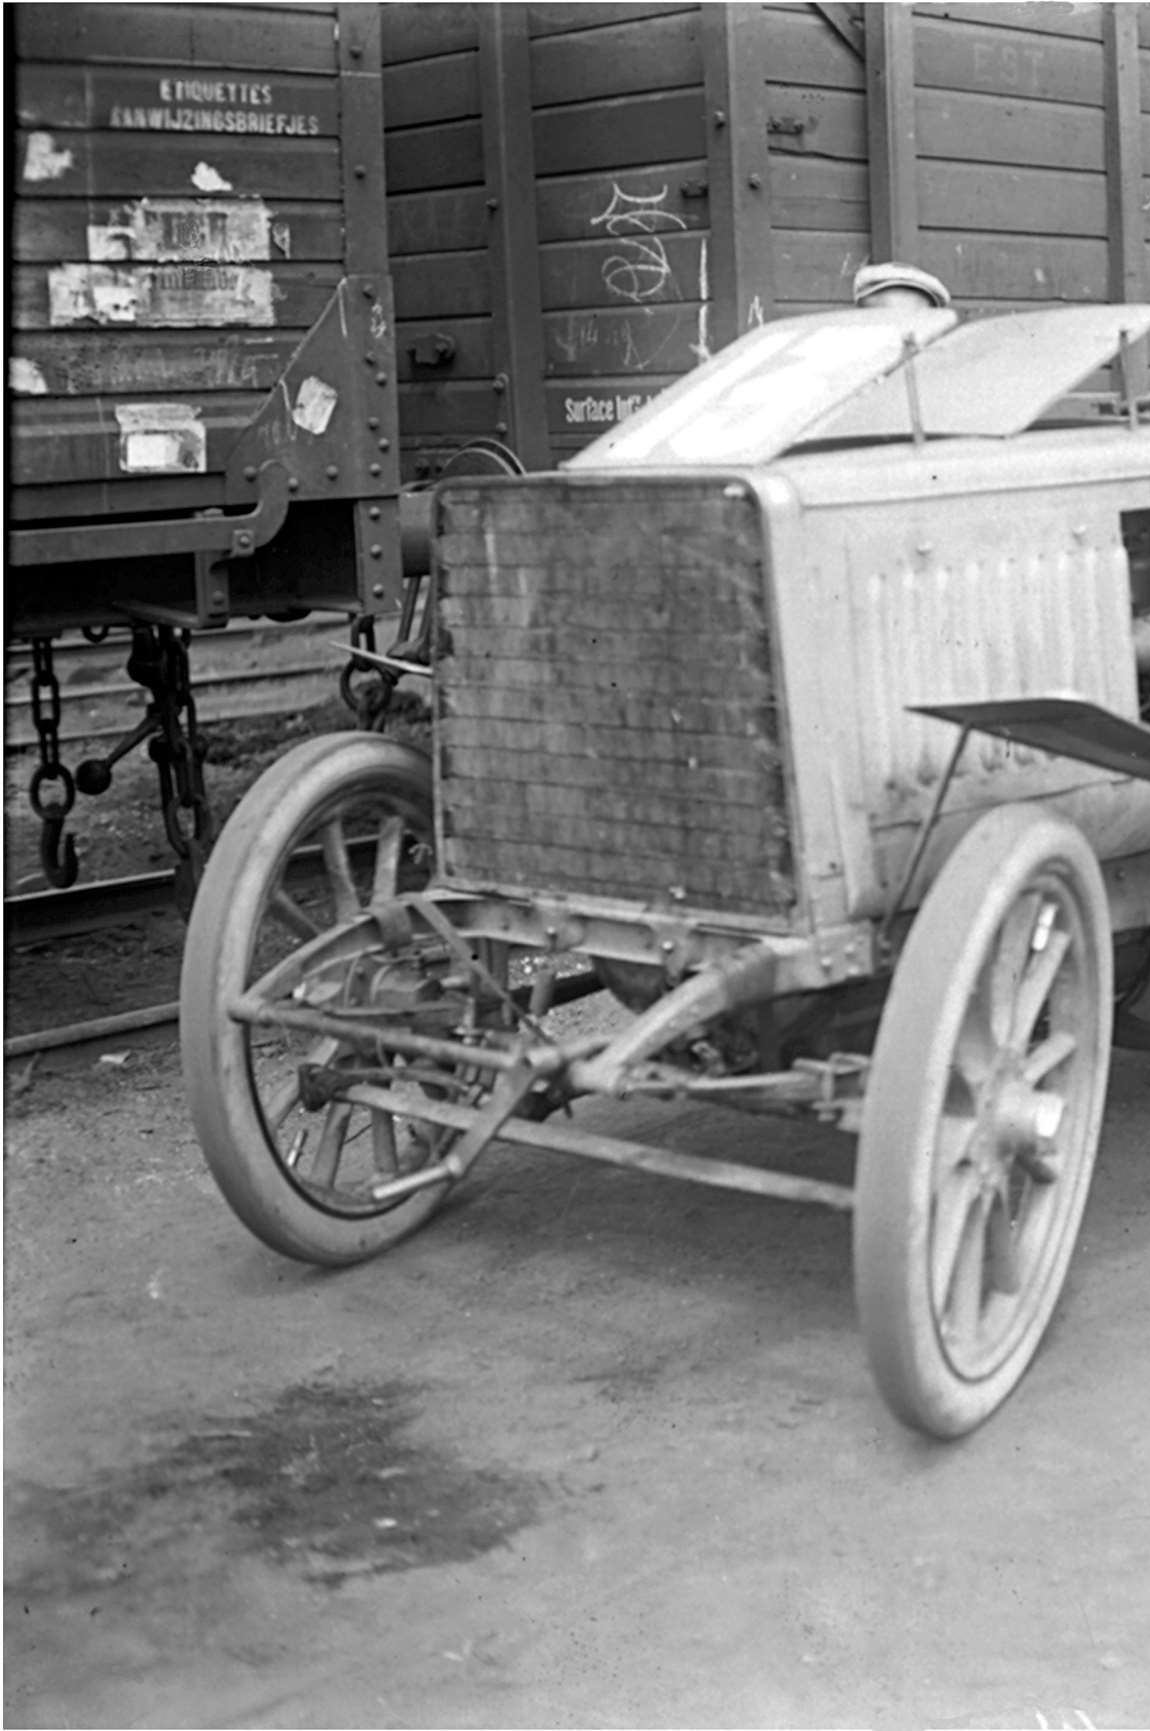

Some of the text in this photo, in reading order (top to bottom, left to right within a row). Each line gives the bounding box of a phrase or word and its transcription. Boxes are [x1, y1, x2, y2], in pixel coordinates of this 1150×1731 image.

[159, 78, 272, 105] ETIQUETTES
[109, 105, 320, 136] AANWIJZINGSBRIEFJES
[565, 397, 614, 422] Surface
